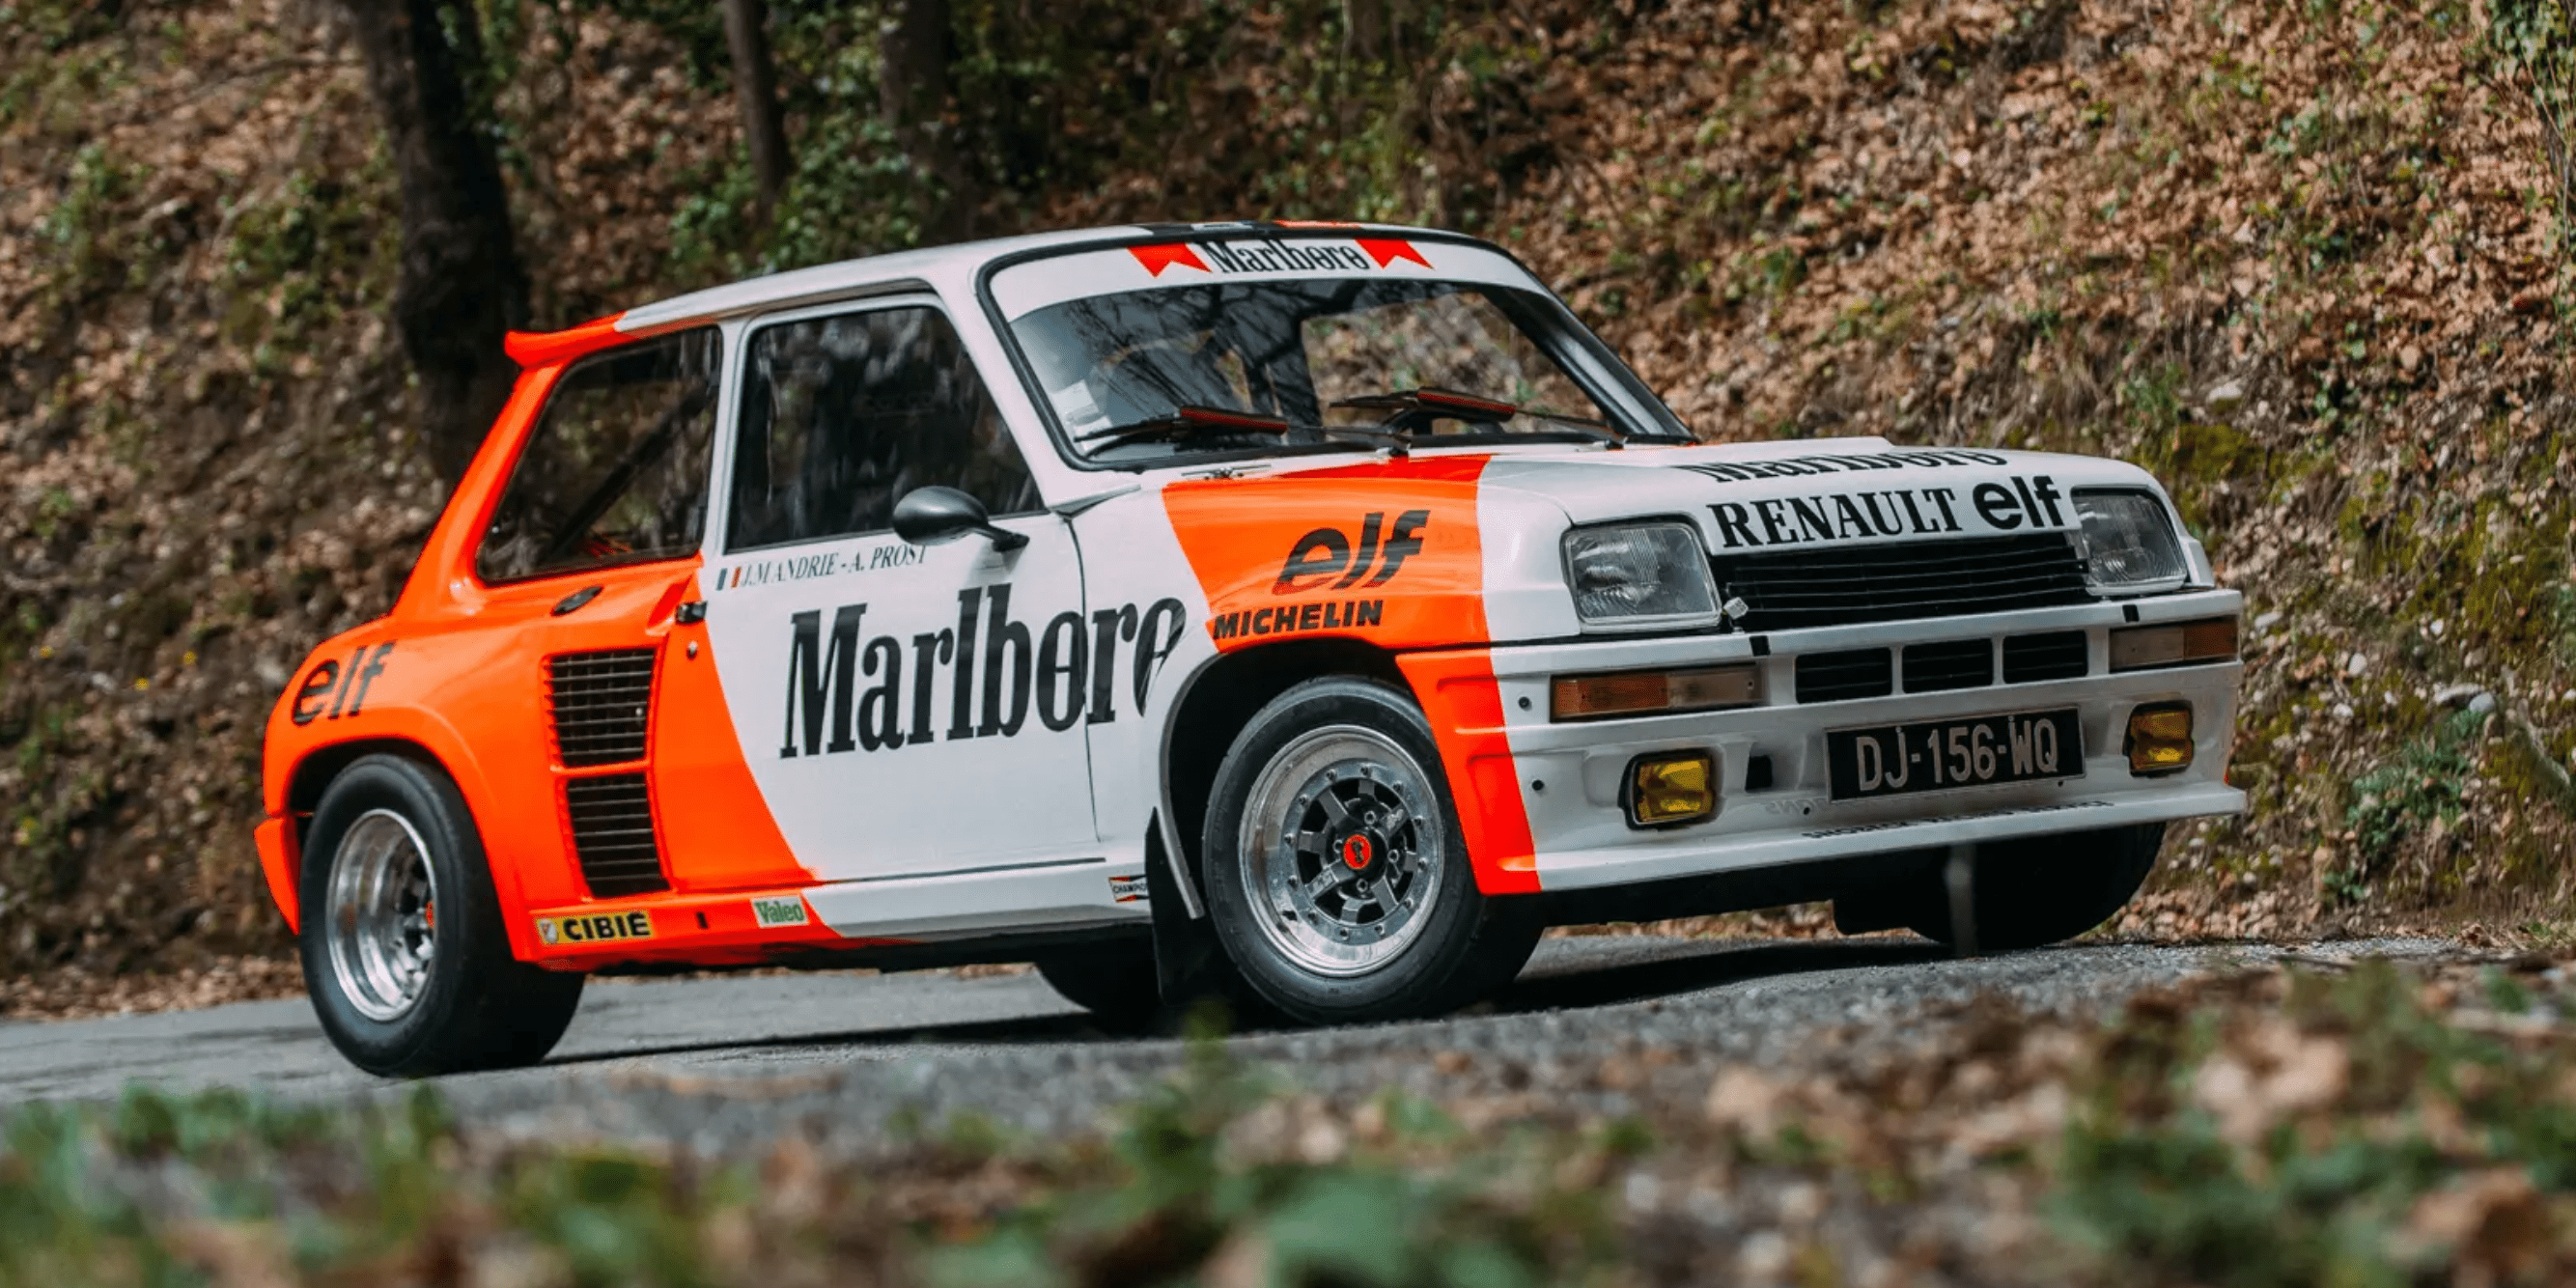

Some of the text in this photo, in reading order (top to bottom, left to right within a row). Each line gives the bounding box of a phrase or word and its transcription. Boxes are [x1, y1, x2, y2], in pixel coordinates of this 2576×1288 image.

[1706, 475, 2064, 547] RENAULT elf
[870, 544, 928, 570] PROST
[1271, 509, 1431, 596] elf
[1213, 600, 1384, 640] MICHELIN
[292, 639, 398, 727] elf
[1856, 717, 2059, 792] DJ-156-WQ
[753, 900, 805, 924] Valeo
